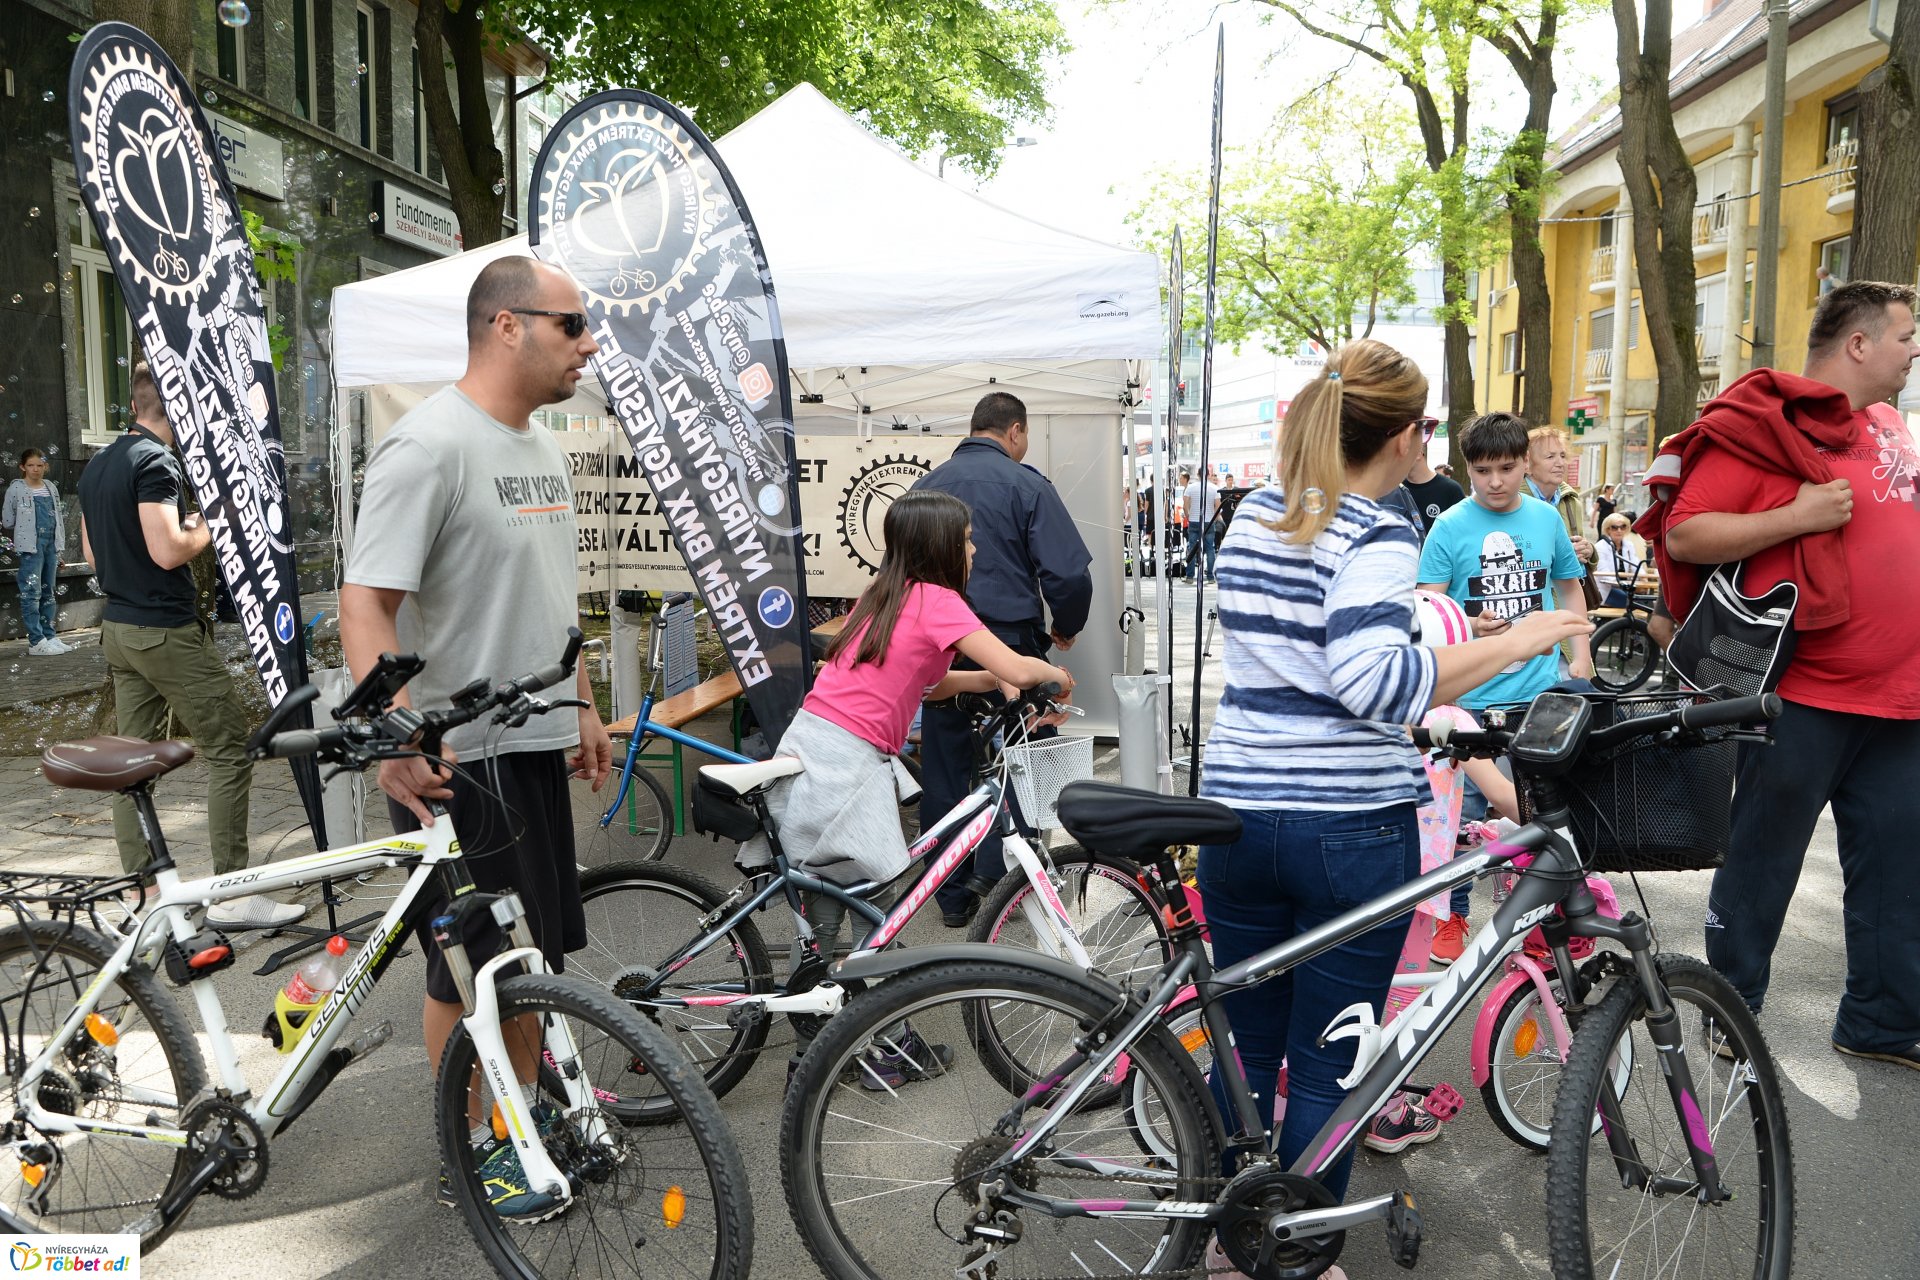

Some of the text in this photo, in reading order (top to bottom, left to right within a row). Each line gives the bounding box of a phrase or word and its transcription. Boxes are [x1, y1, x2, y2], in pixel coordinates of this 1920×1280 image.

[213, 119, 247, 163] ter
[396, 197, 452, 236] Fundamenta
[396, 220, 452, 248] SZEMÉLYI BANKÁR
[1248, 463, 1265, 476] SPAR
[494, 475, 570, 507] NEW YORK
[1507, 560, 1541, 573] STAY REAL
[1481, 571, 1538, 595] SKATE
[210, 871, 266, 890] razor
[1512, 903, 1556, 934] KTM
[368, 922, 404, 972] race line
[311, 927, 386, 1038] GENESIS
[1155, 1201, 1208, 1213] KTM
